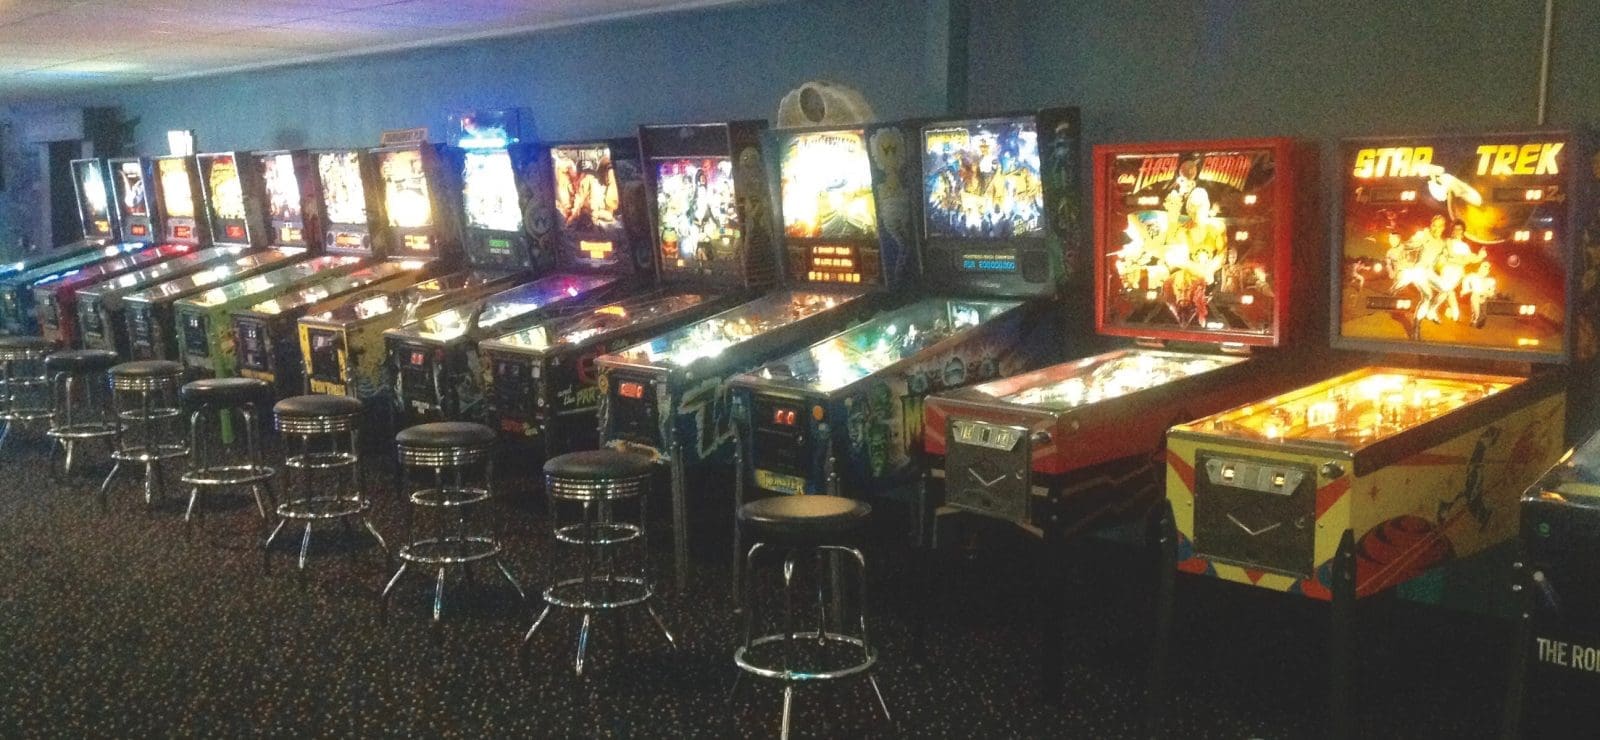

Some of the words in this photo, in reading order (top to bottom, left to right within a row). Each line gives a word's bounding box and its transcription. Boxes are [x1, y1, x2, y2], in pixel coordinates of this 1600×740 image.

[1133, 155, 1179, 194] FLASH
[1199, 154, 1252, 192] GORDON
[1354, 146, 1434, 178] STAR
[1476, 142, 1565, 176] TREK
[1536, 637, 1568, 667] THE
